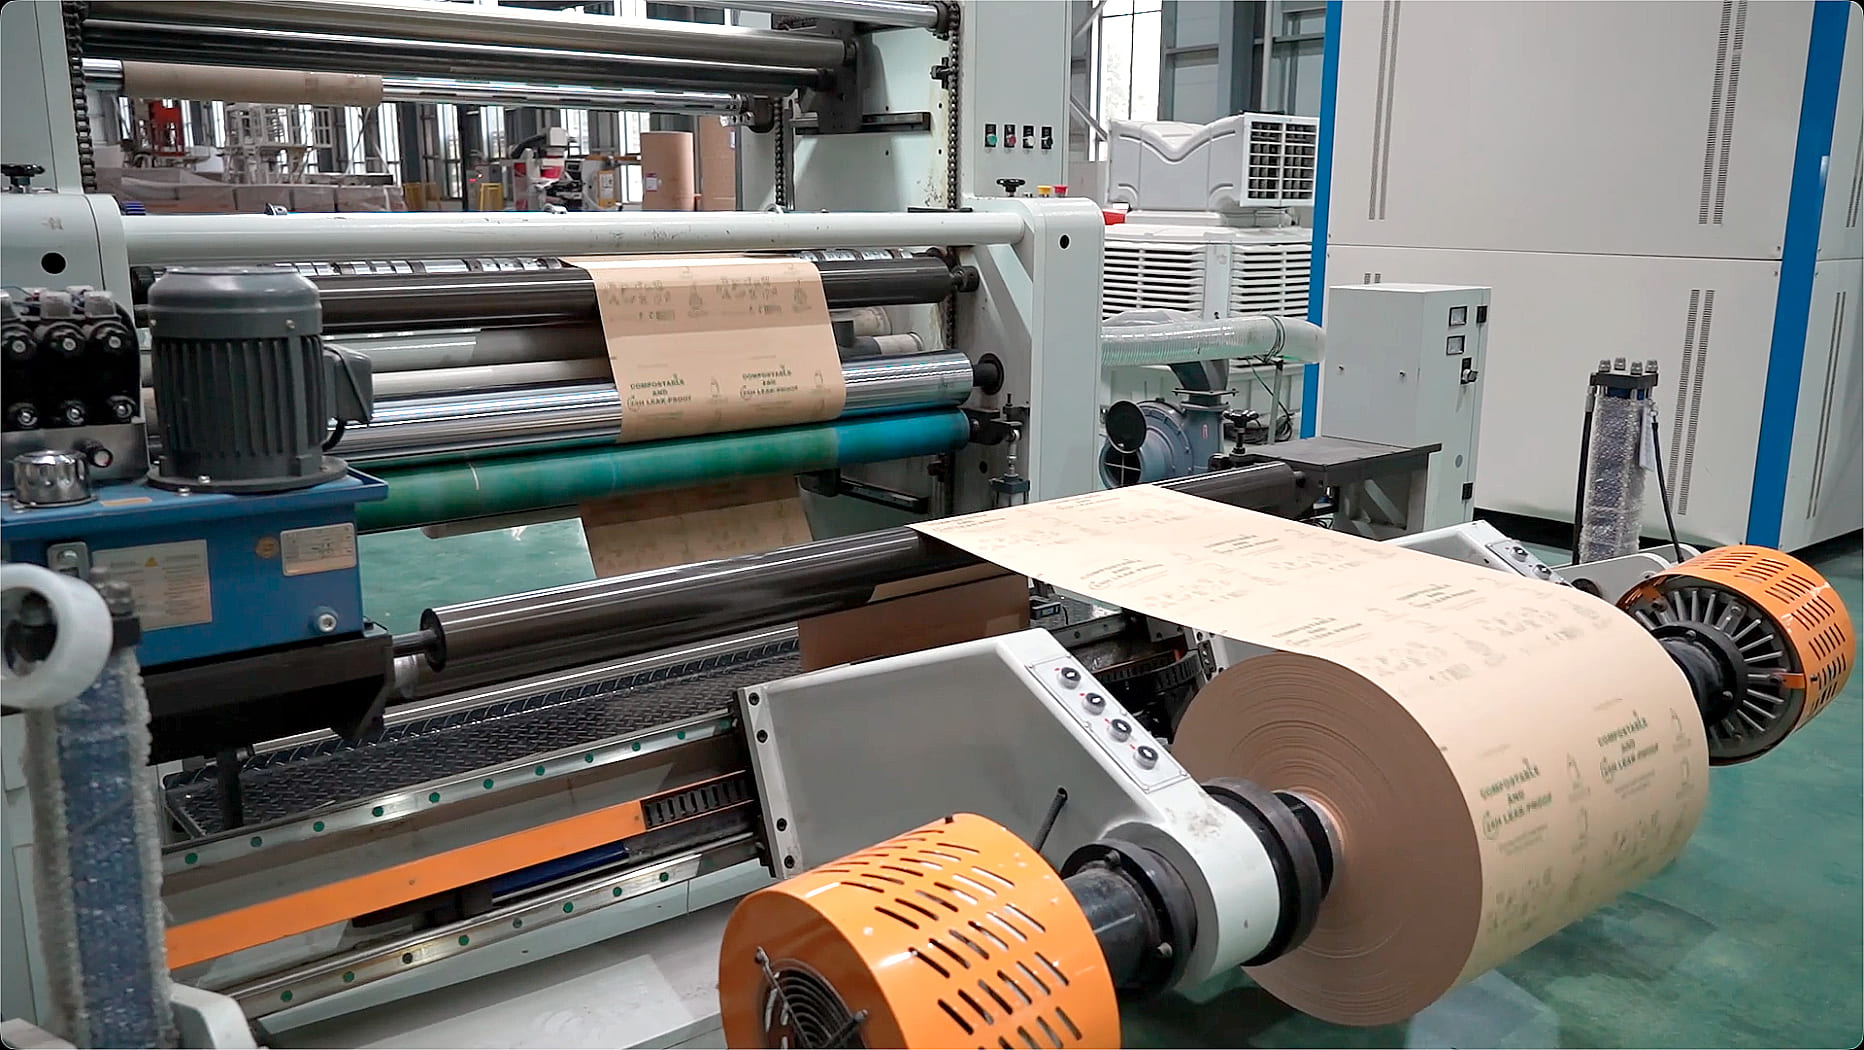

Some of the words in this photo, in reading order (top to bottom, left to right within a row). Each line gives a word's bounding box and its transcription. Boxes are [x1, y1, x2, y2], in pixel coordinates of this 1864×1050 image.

[630, 379, 685, 390] COMPOSTABLE
[652, 388, 668, 397] AND
[1597, 716, 1649, 748] COMPOSTABLE
[1479, 764, 1540, 801] COMPOSTABLE
[1506, 788, 1525, 804] AND
[1502, 804, 1525, 825] LEAK
